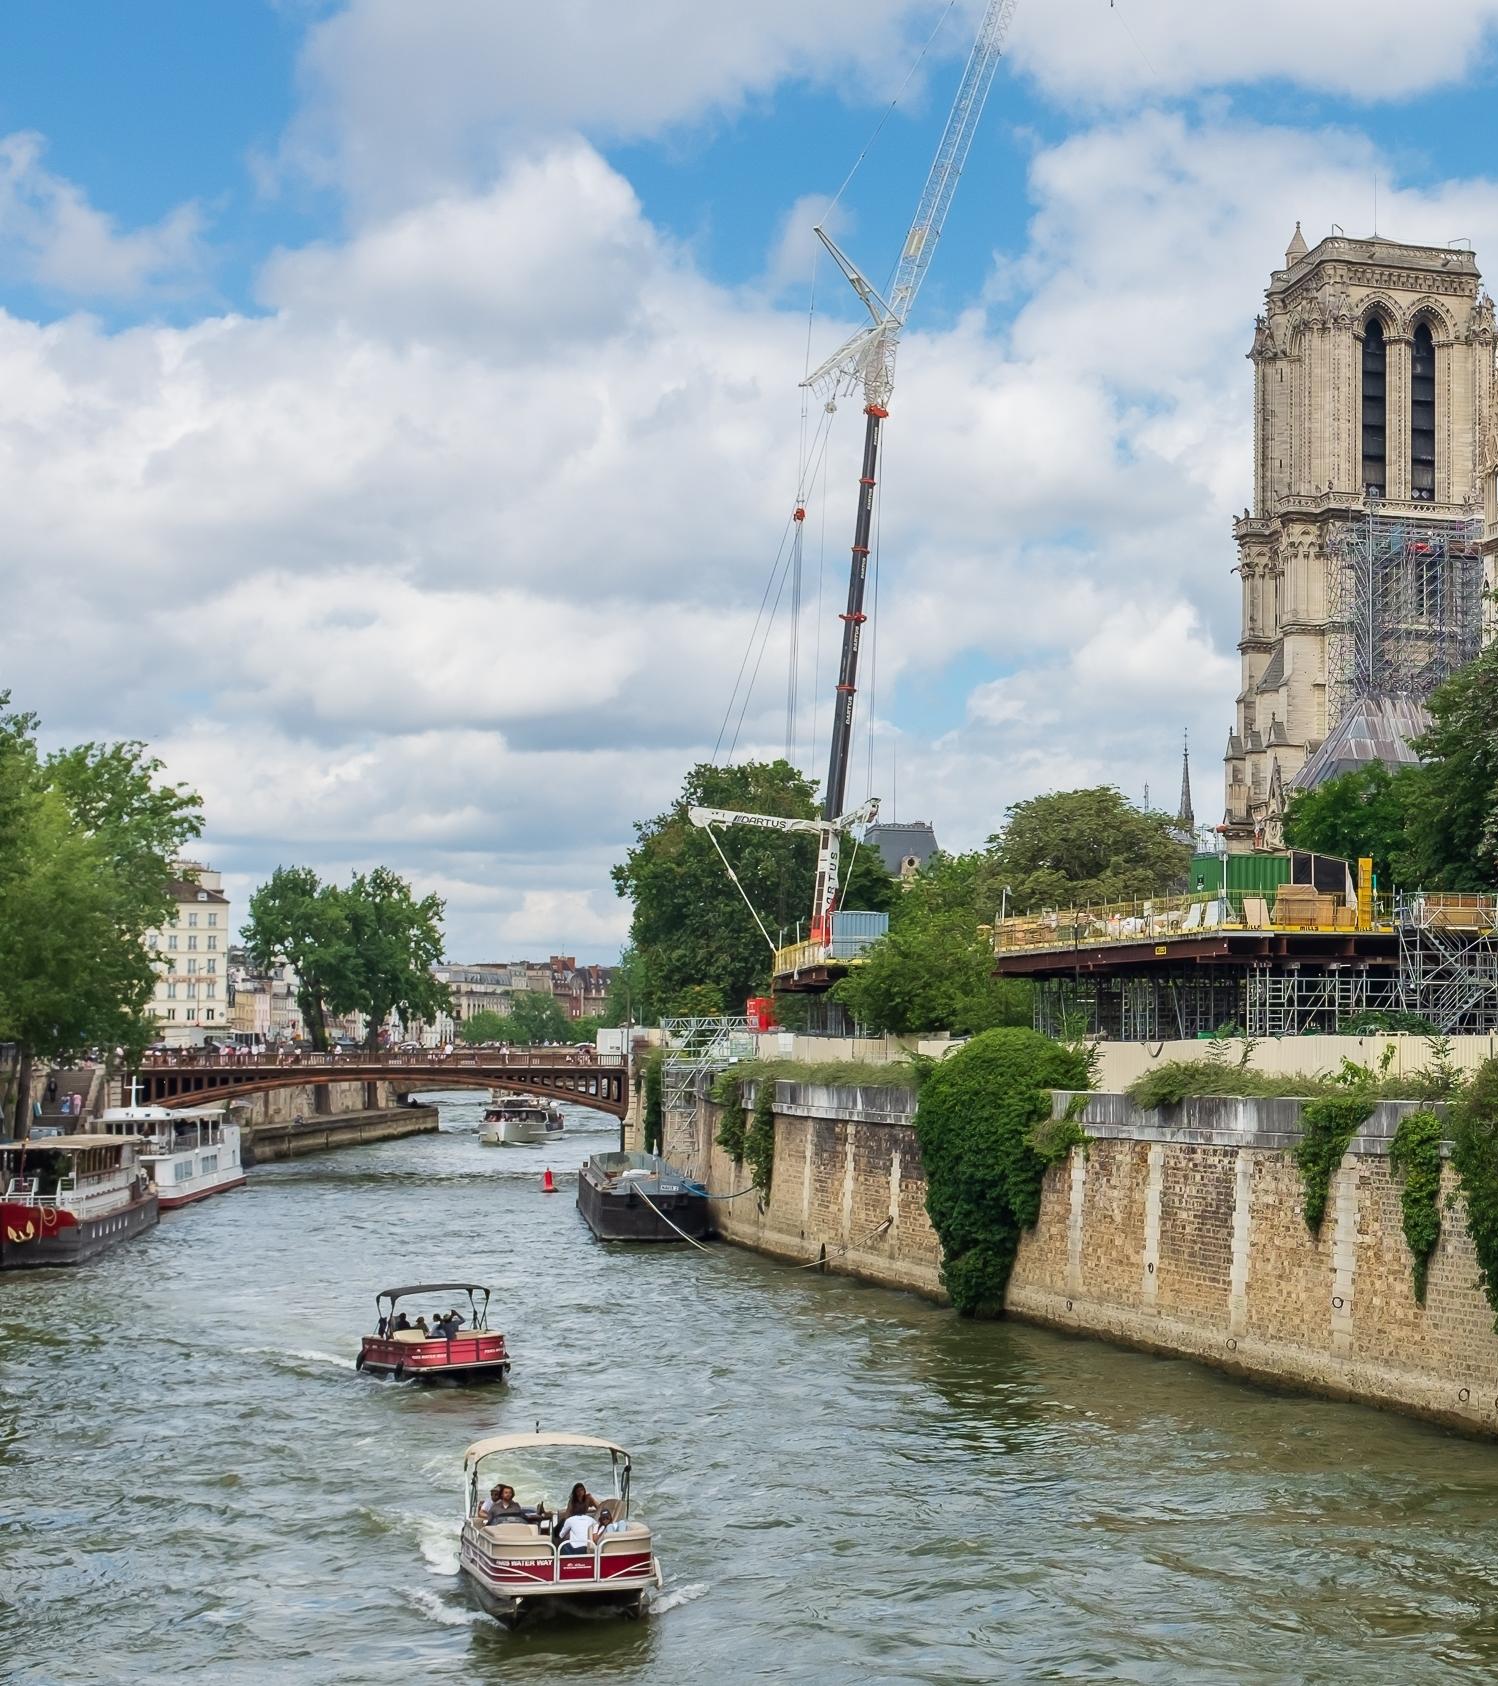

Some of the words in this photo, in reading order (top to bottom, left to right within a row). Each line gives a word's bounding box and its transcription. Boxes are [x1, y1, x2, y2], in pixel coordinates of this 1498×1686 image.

[845, 695, 853, 725] DARTUS
[741, 816, 787, 829] DARTUS
[825, 851, 838, 913] ARTUS
[537, 1559, 553, 1567] WAY
